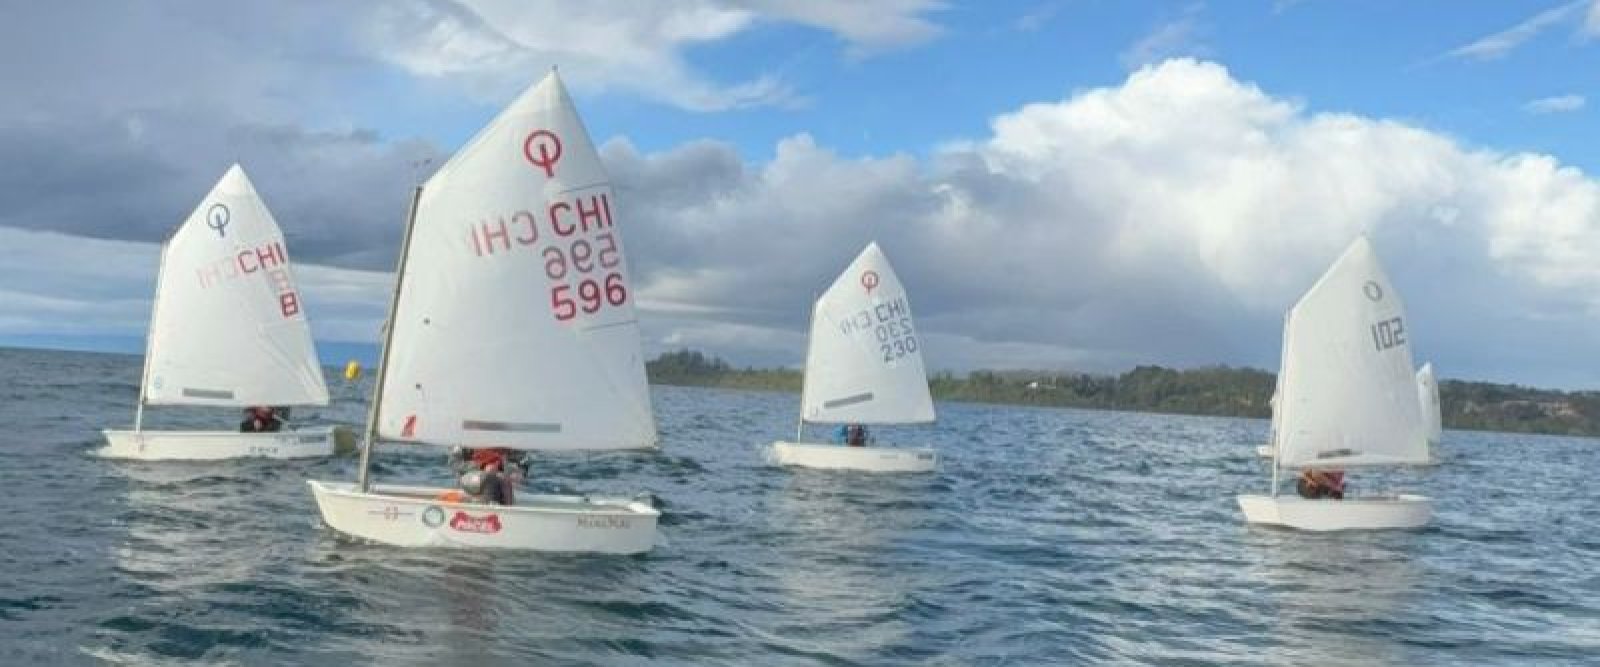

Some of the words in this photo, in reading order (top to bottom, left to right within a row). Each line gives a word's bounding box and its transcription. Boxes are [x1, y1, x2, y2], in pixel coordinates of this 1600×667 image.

[549, 193, 613, 237] CHI
[238, 241, 286, 273] CHI
[551, 272, 627, 322] 596
[874, 298, 907, 323] CHI
[880, 335, 917, 362] 230
[1370, 316, 1406, 352] 102
